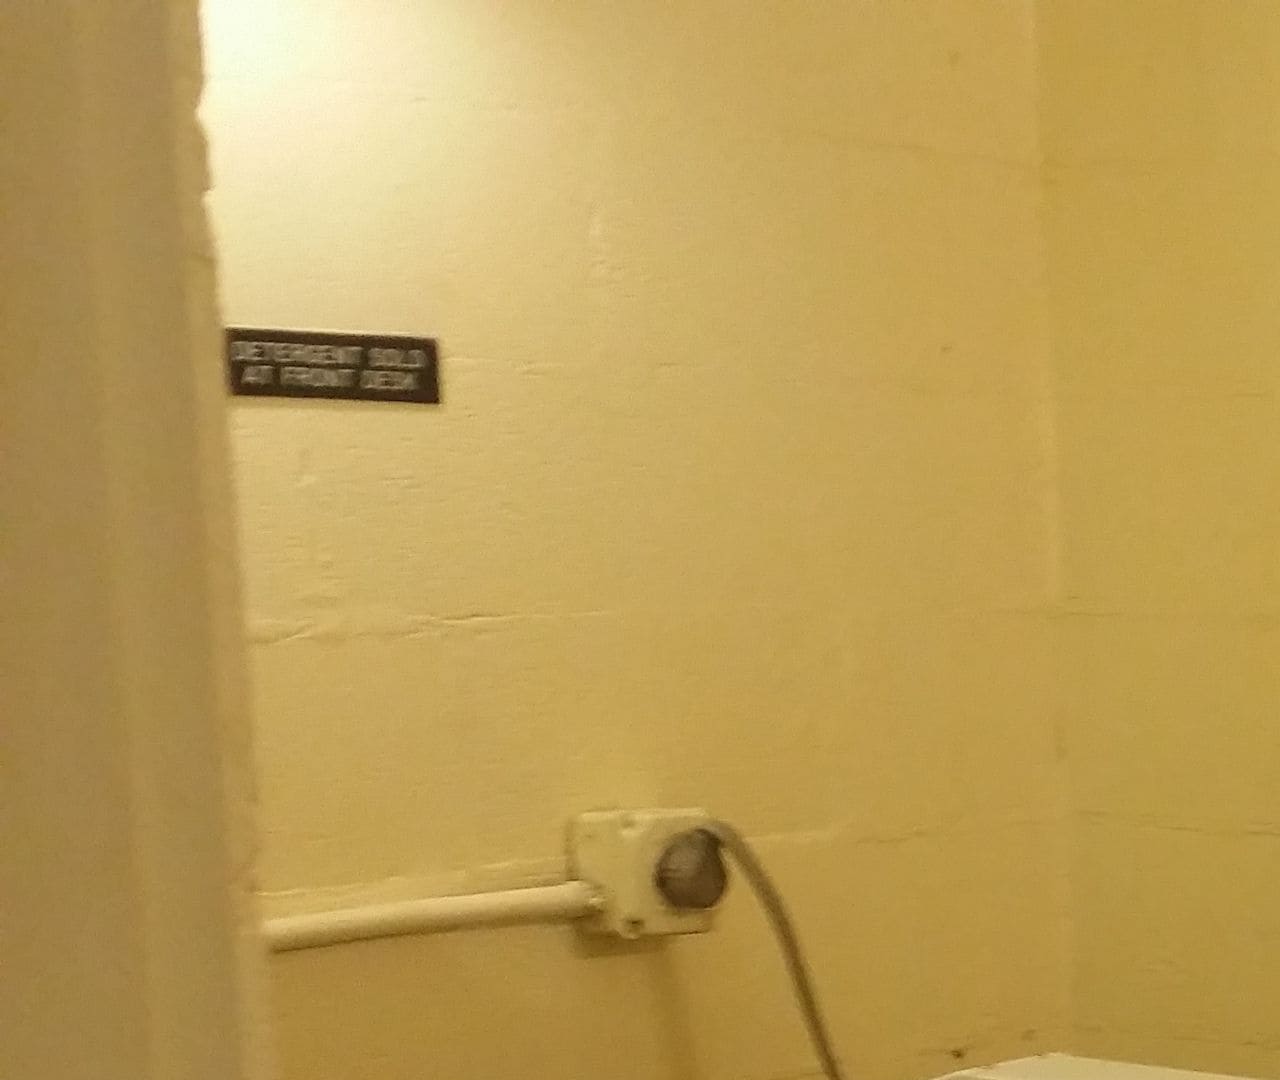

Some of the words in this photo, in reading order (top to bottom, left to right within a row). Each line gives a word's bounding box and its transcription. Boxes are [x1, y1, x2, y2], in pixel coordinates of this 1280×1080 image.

[231, 341, 363, 364] DETERGENT
[367, 347, 427, 369] SOLD
[241, 365, 275, 385] AT
[279, 366, 357, 388] FRONT
[360, 369, 420, 390] DESK
